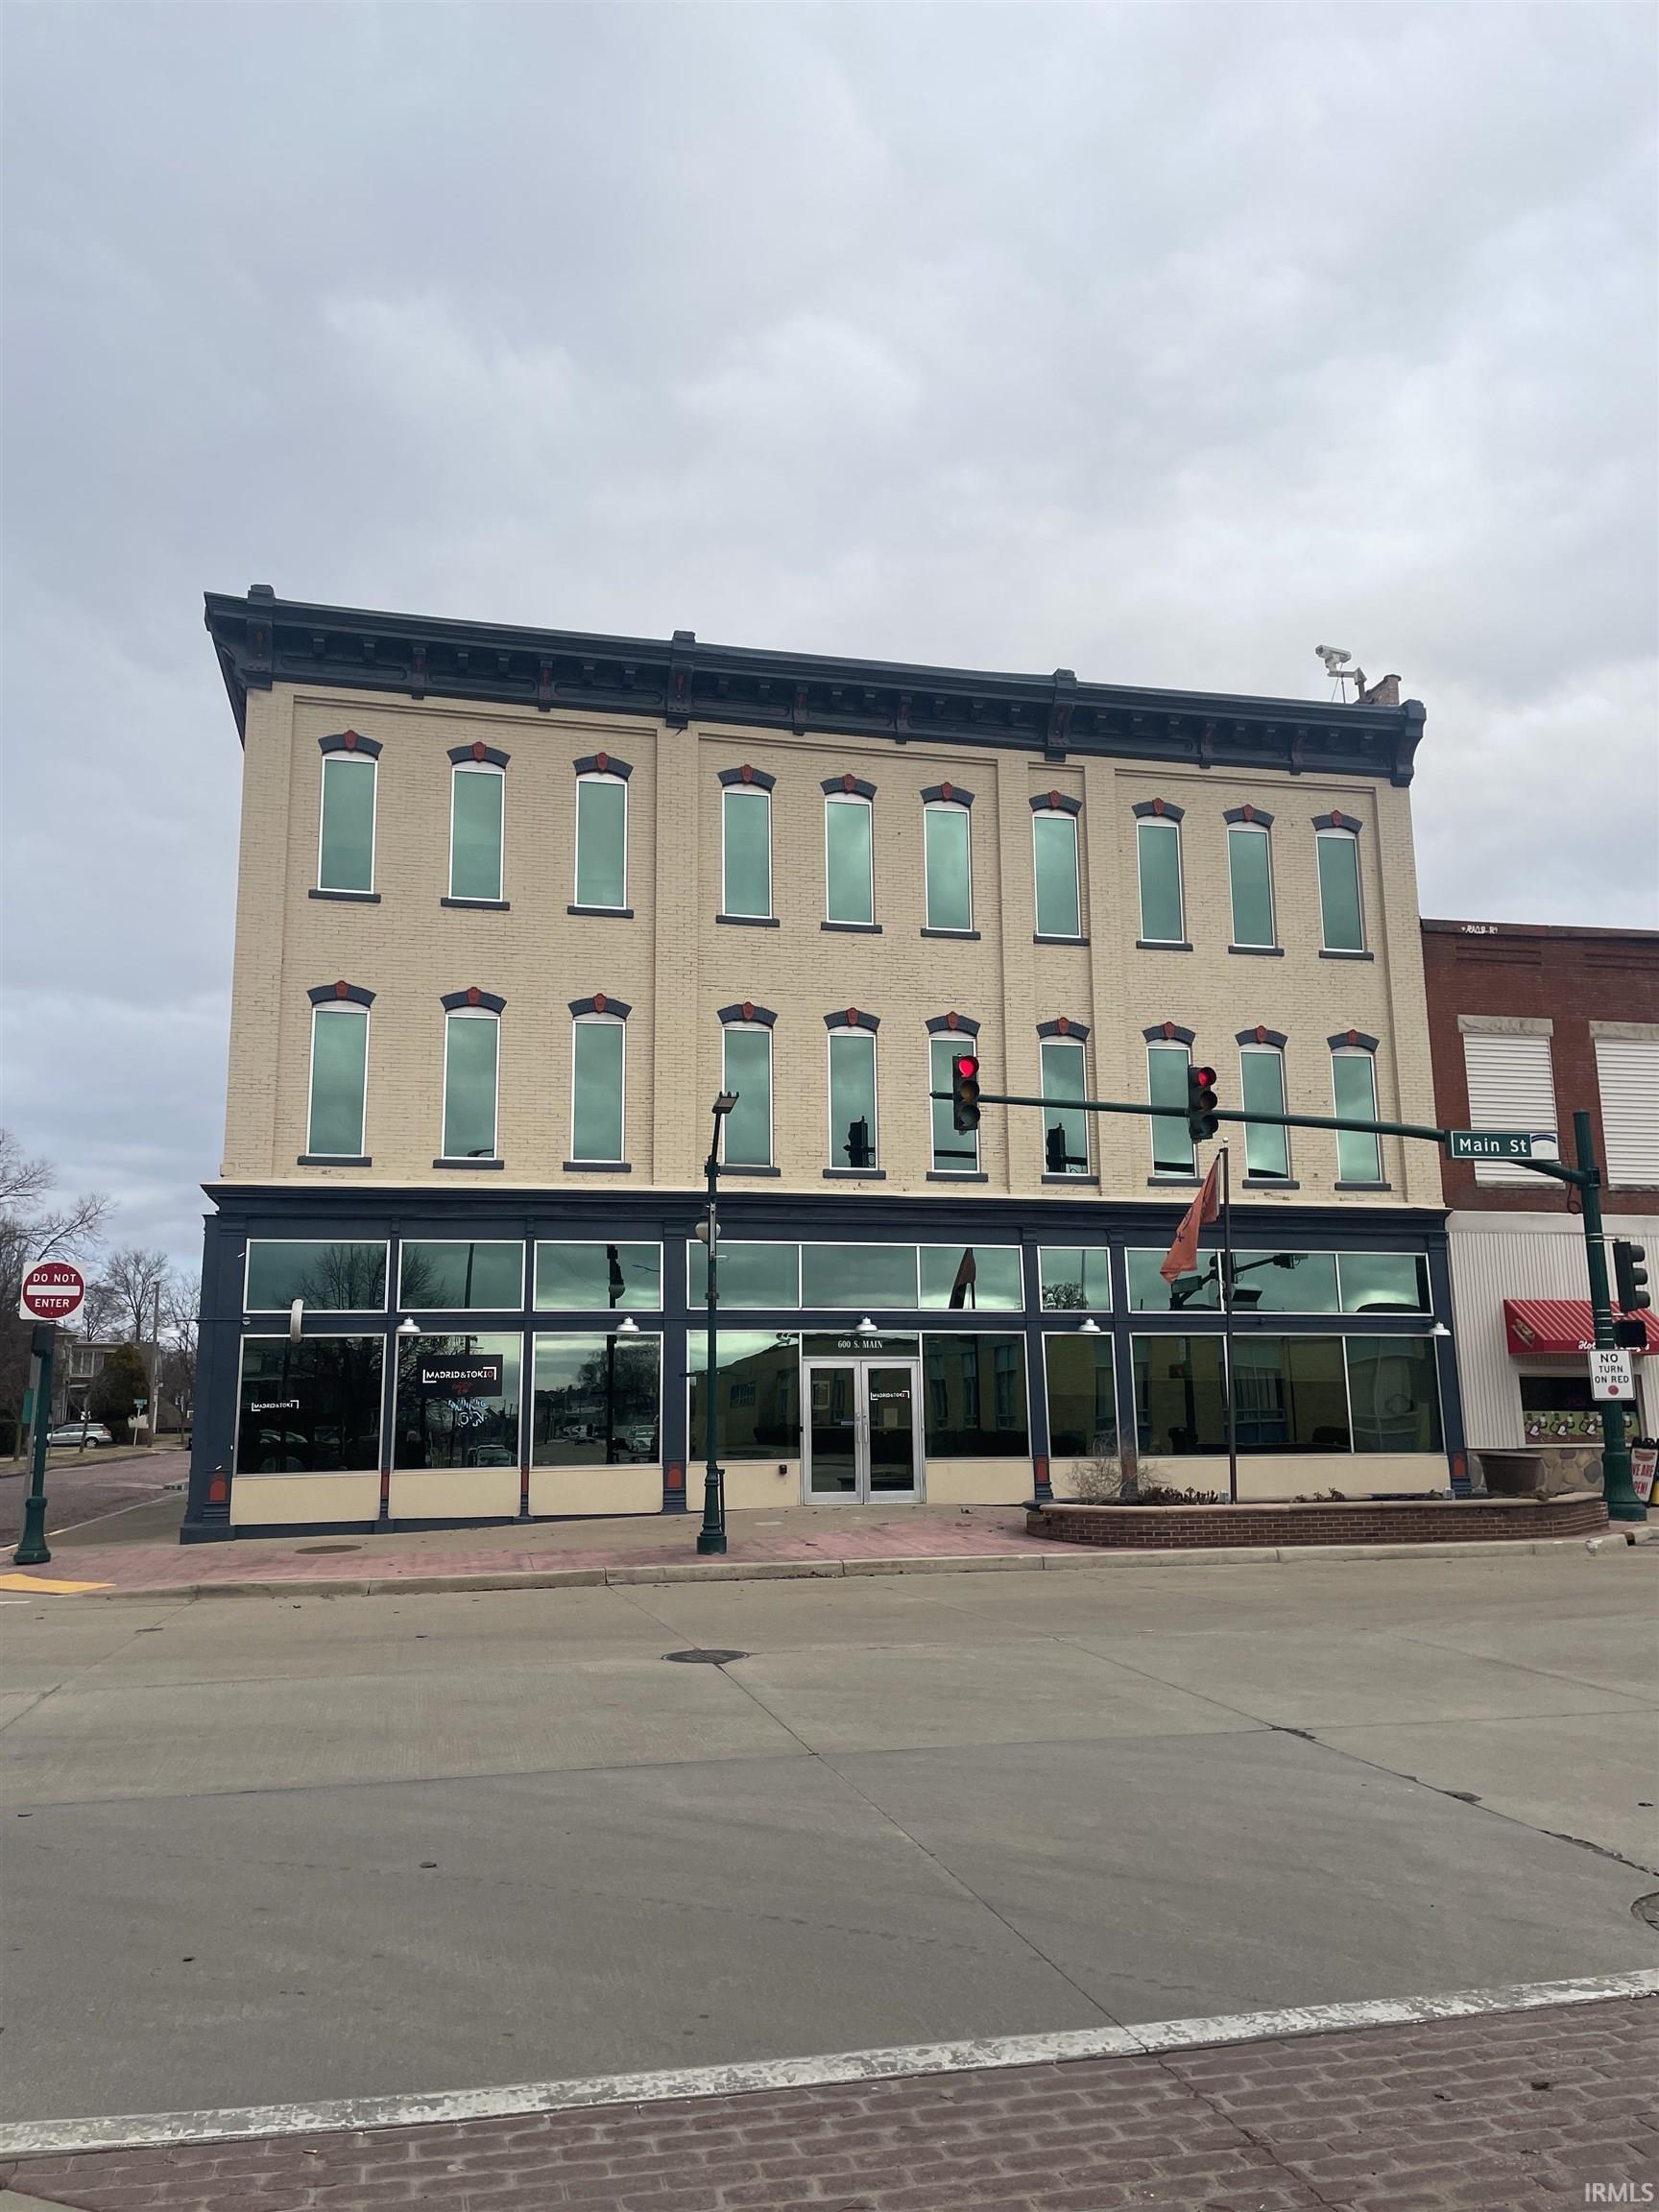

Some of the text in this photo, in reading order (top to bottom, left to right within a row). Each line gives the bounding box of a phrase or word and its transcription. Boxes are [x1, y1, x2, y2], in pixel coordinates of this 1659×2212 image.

[1459, 1138, 1527, 1152] Main St
[33, 1273, 76, 1283] DO NOT
[35, 1298, 70, 1308] ENTER
[837, 1340, 883, 1349] 600 S. MAIN
[1577, 1340, 1597, 1350] Hot
[1600, 1354, 1619, 1363] NO
[425, 1369, 493, 1380] MADRID&TOKIO
[1599, 1365, 1623, 1374] TURN
[1641, 1464, 1654, 1478] ARE
